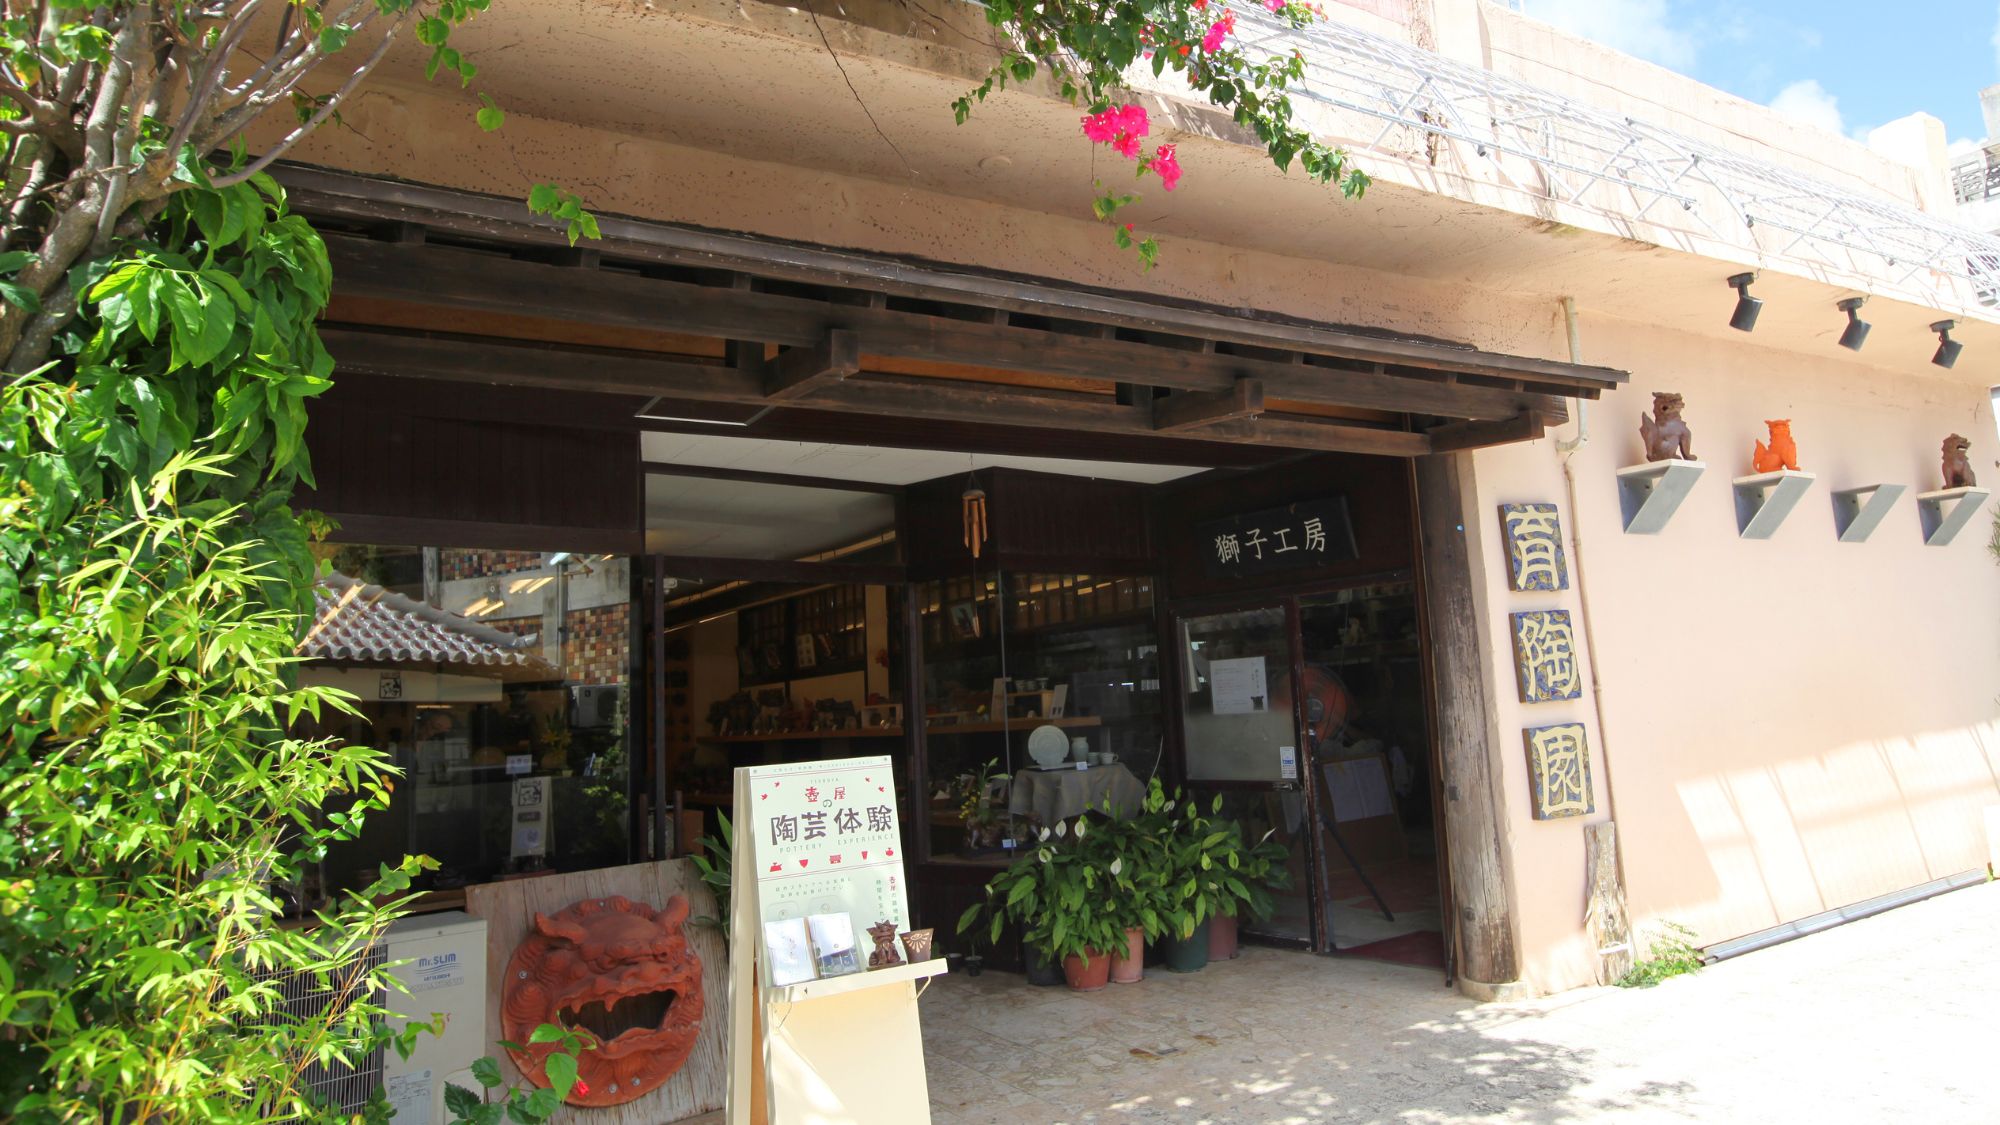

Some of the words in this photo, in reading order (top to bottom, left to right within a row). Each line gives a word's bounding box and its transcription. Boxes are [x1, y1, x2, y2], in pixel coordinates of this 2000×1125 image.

[1214, 517, 1327, 564] 獅子工房
[1505, 504, 1589, 817] 育陶園
[770, 804, 893, 846] 陶芸体験
[779, 843, 823, 854] POTTERY
[837, 833, 895, 846] EXPERIENCE
[418, 953, 457, 968] Mr.SLIM
